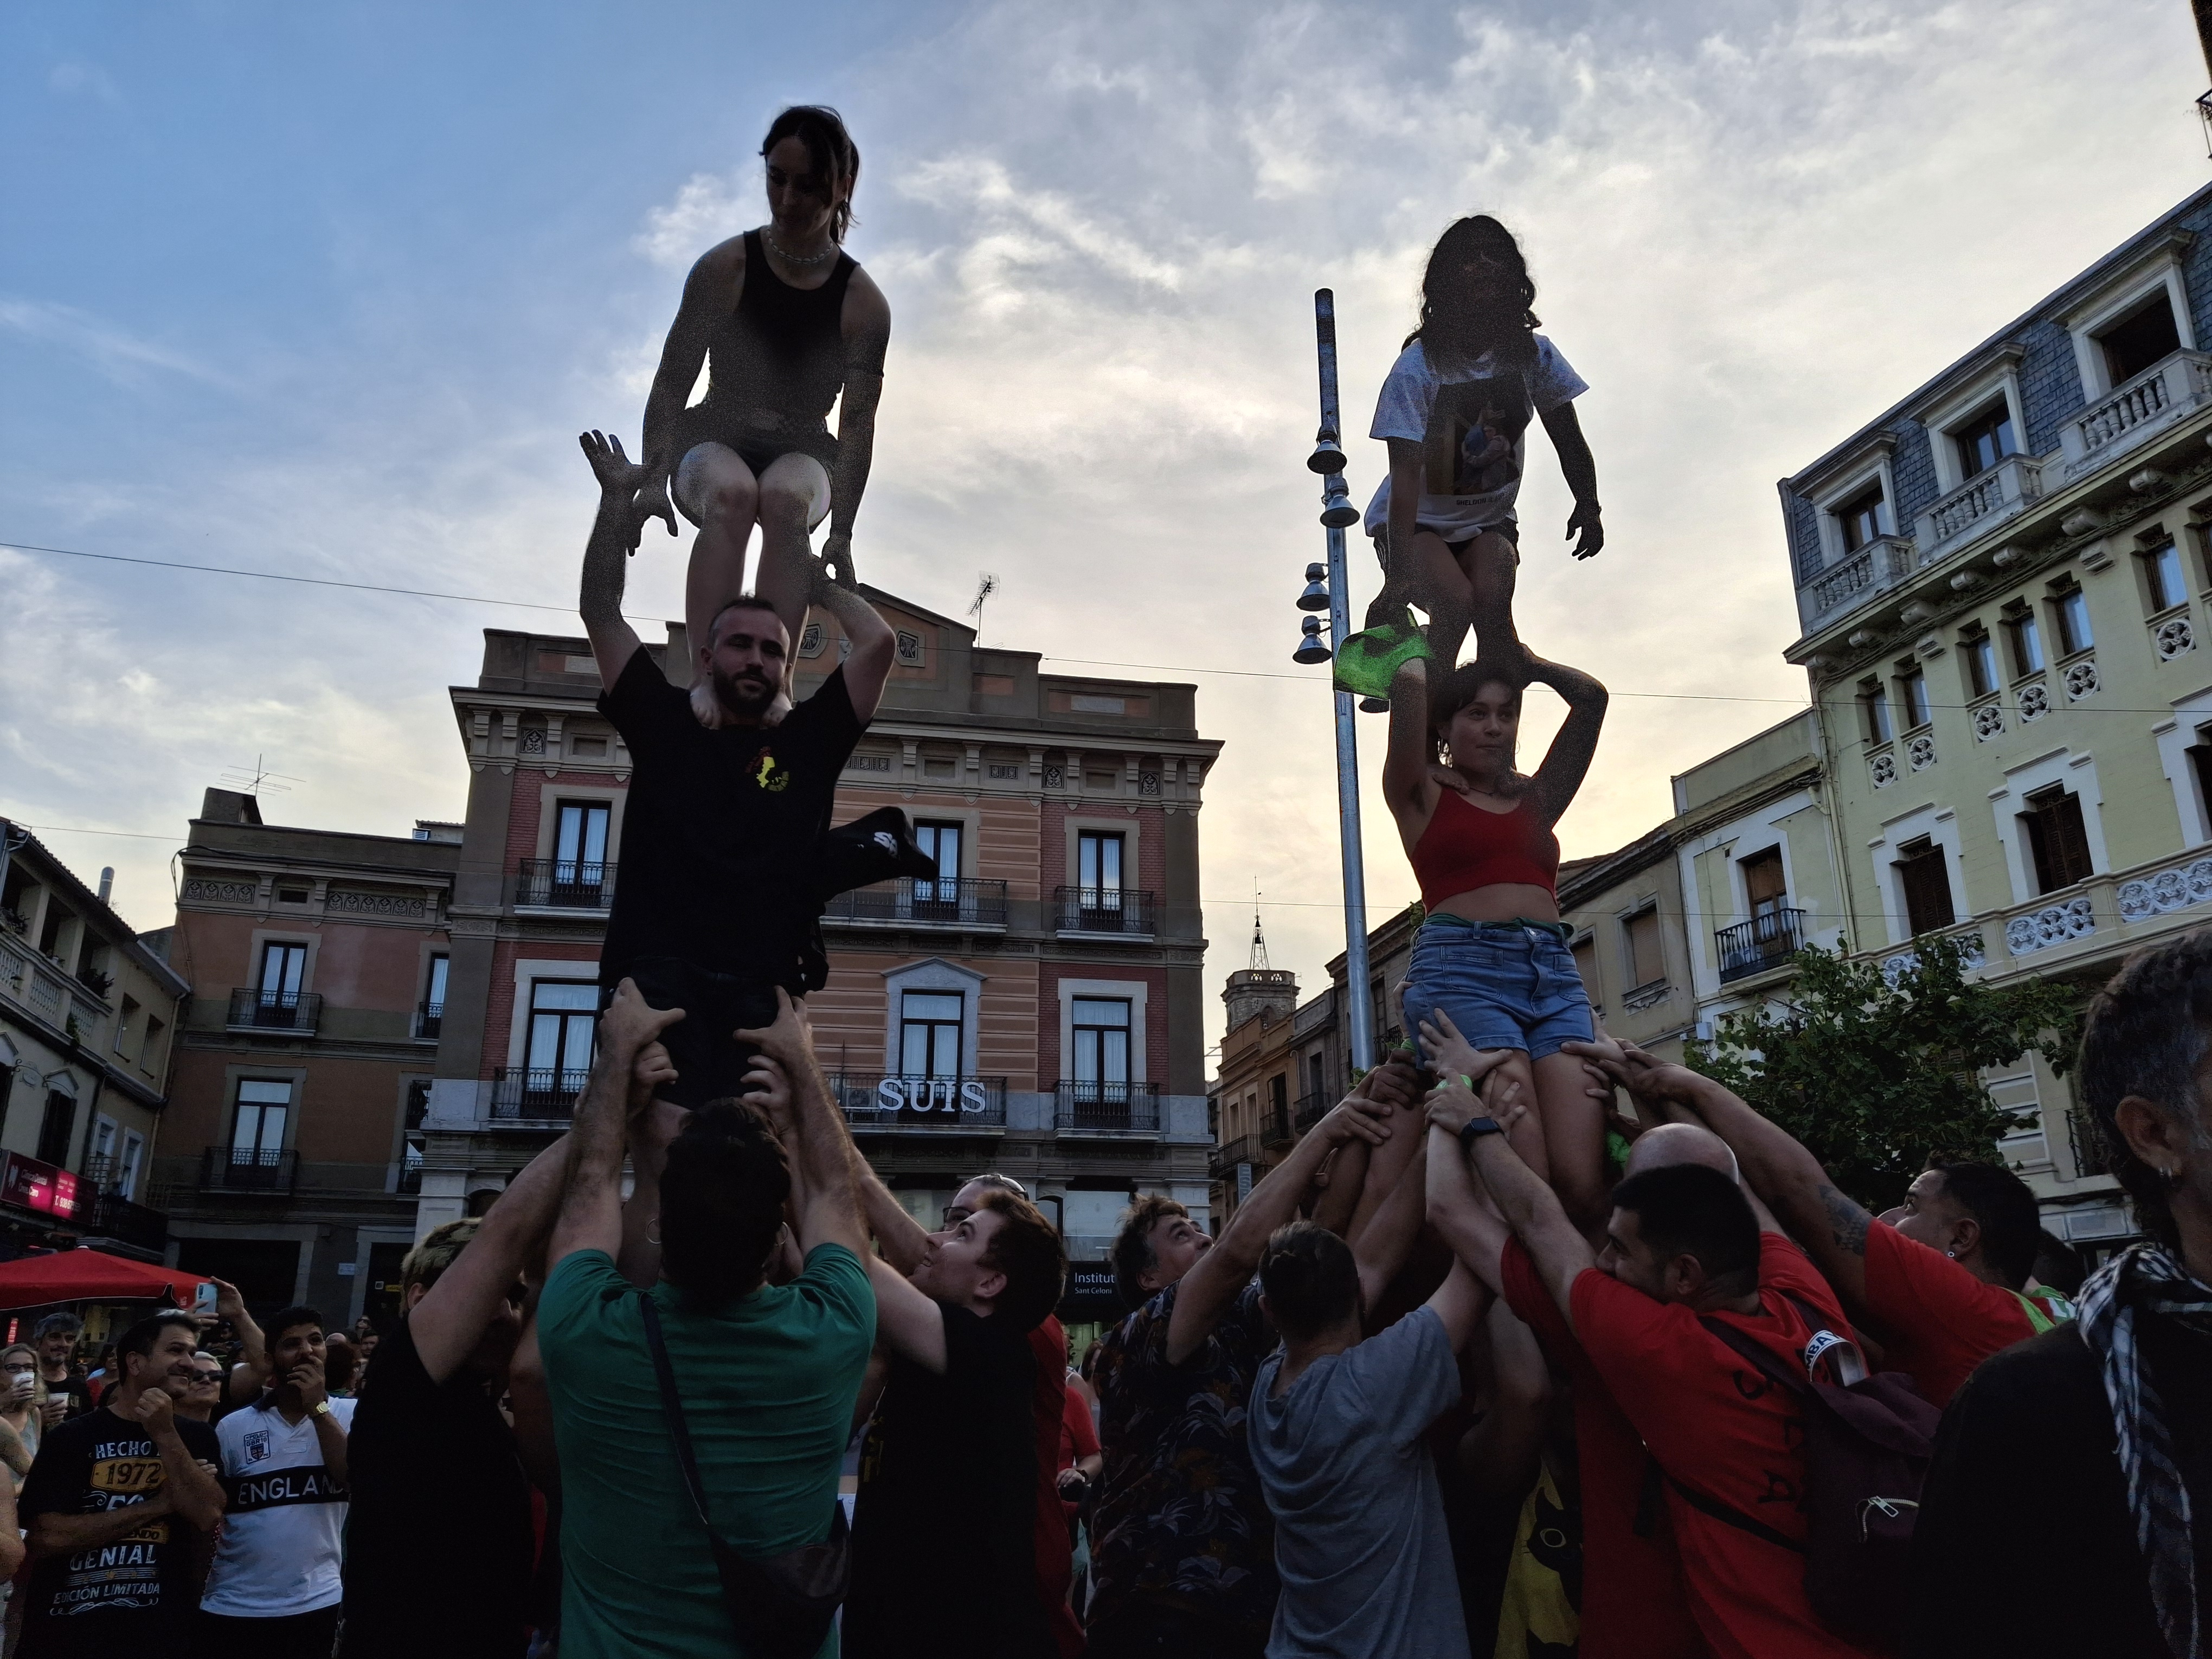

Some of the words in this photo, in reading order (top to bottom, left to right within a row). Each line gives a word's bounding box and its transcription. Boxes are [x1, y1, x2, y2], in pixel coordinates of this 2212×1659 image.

[878, 1079, 986, 1113] SUIS
[1075, 1272, 1116, 1283] Institut
[95, 1441, 152, 1459] HECHO
[106, 1463, 161, 1485] 1972
[70, 1545, 157, 1571] GENIAL
[53, 1585, 101, 1604] EDICIÓN
[103, 1583, 160, 1597] LIMITADA
